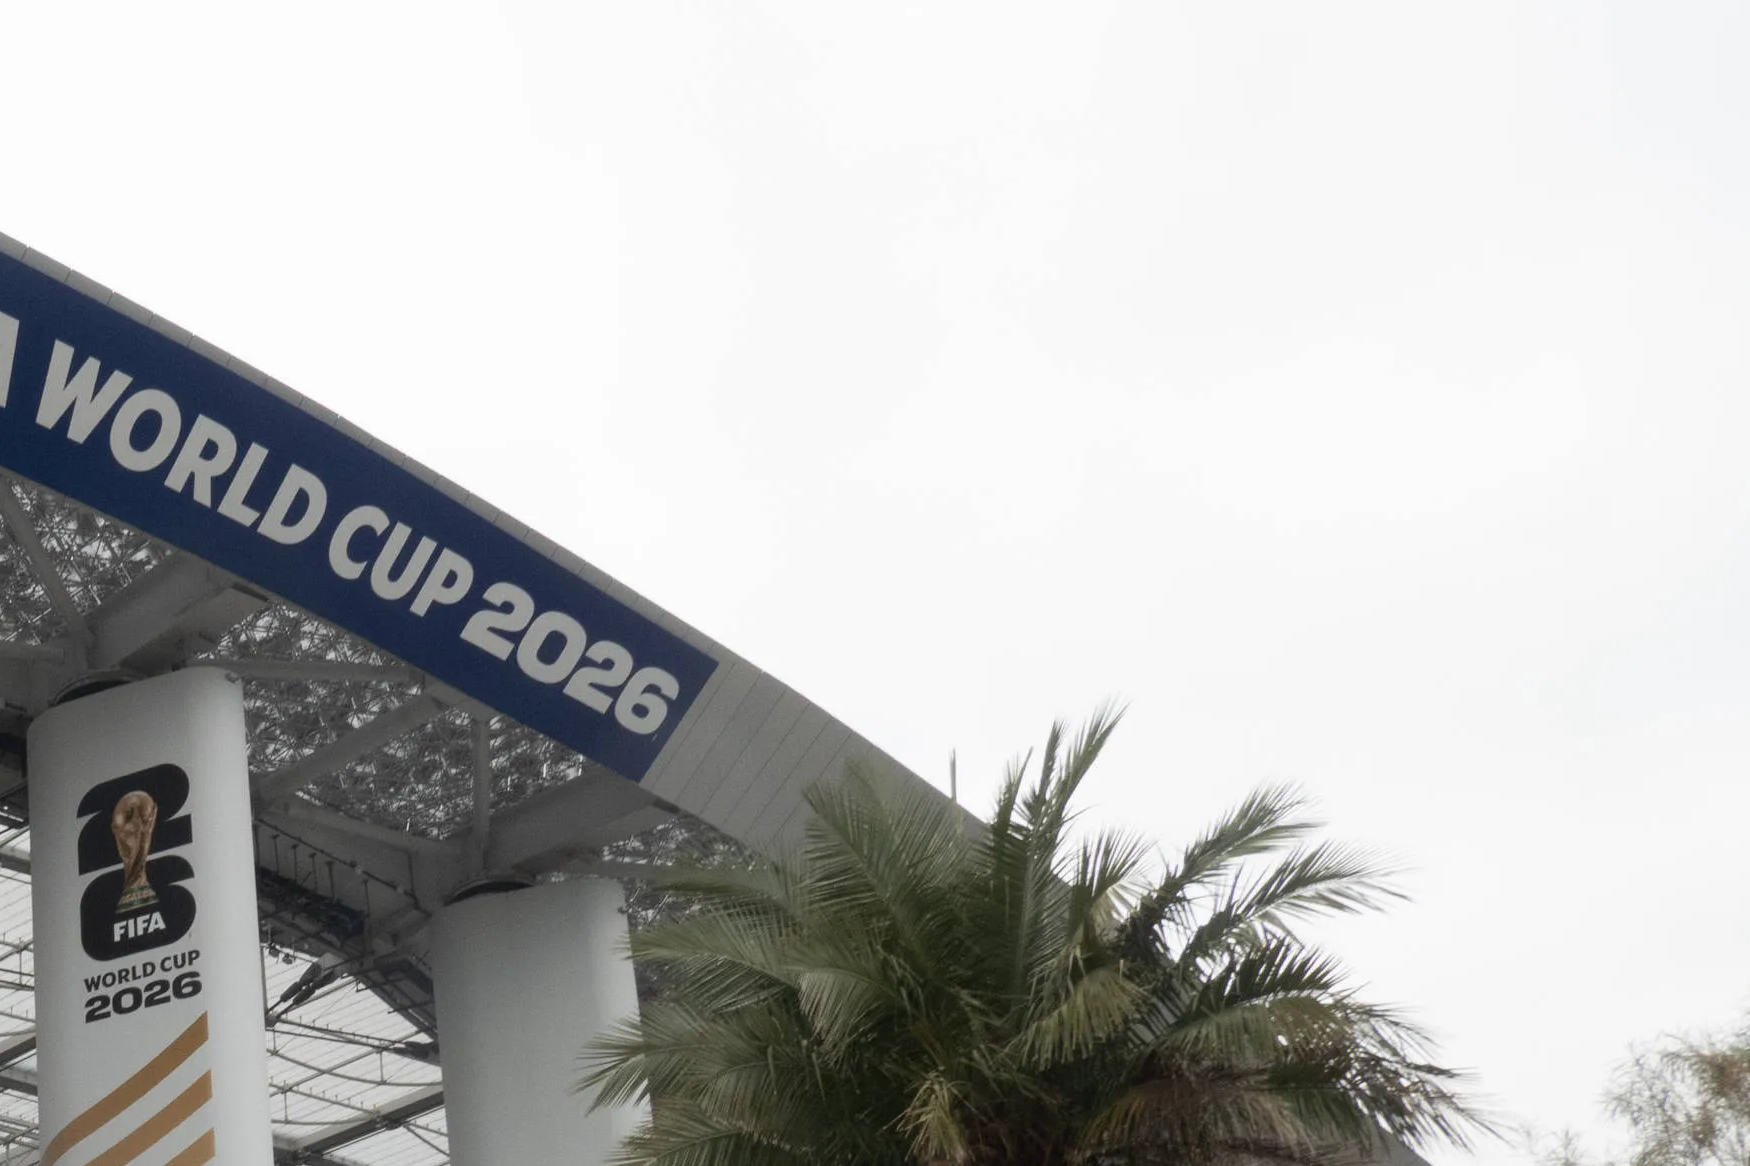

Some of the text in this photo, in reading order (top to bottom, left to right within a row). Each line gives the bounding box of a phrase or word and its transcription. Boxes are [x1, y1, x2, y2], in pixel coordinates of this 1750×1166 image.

[35, 338, 328, 545] WORLD
[328, 505, 474, 617] CUP
[459, 582, 680, 735] 2026
[113, 911, 166, 942] FIFA
[84, 949, 201, 993] WORLD CUP
[84, 971, 203, 1024] 2026
